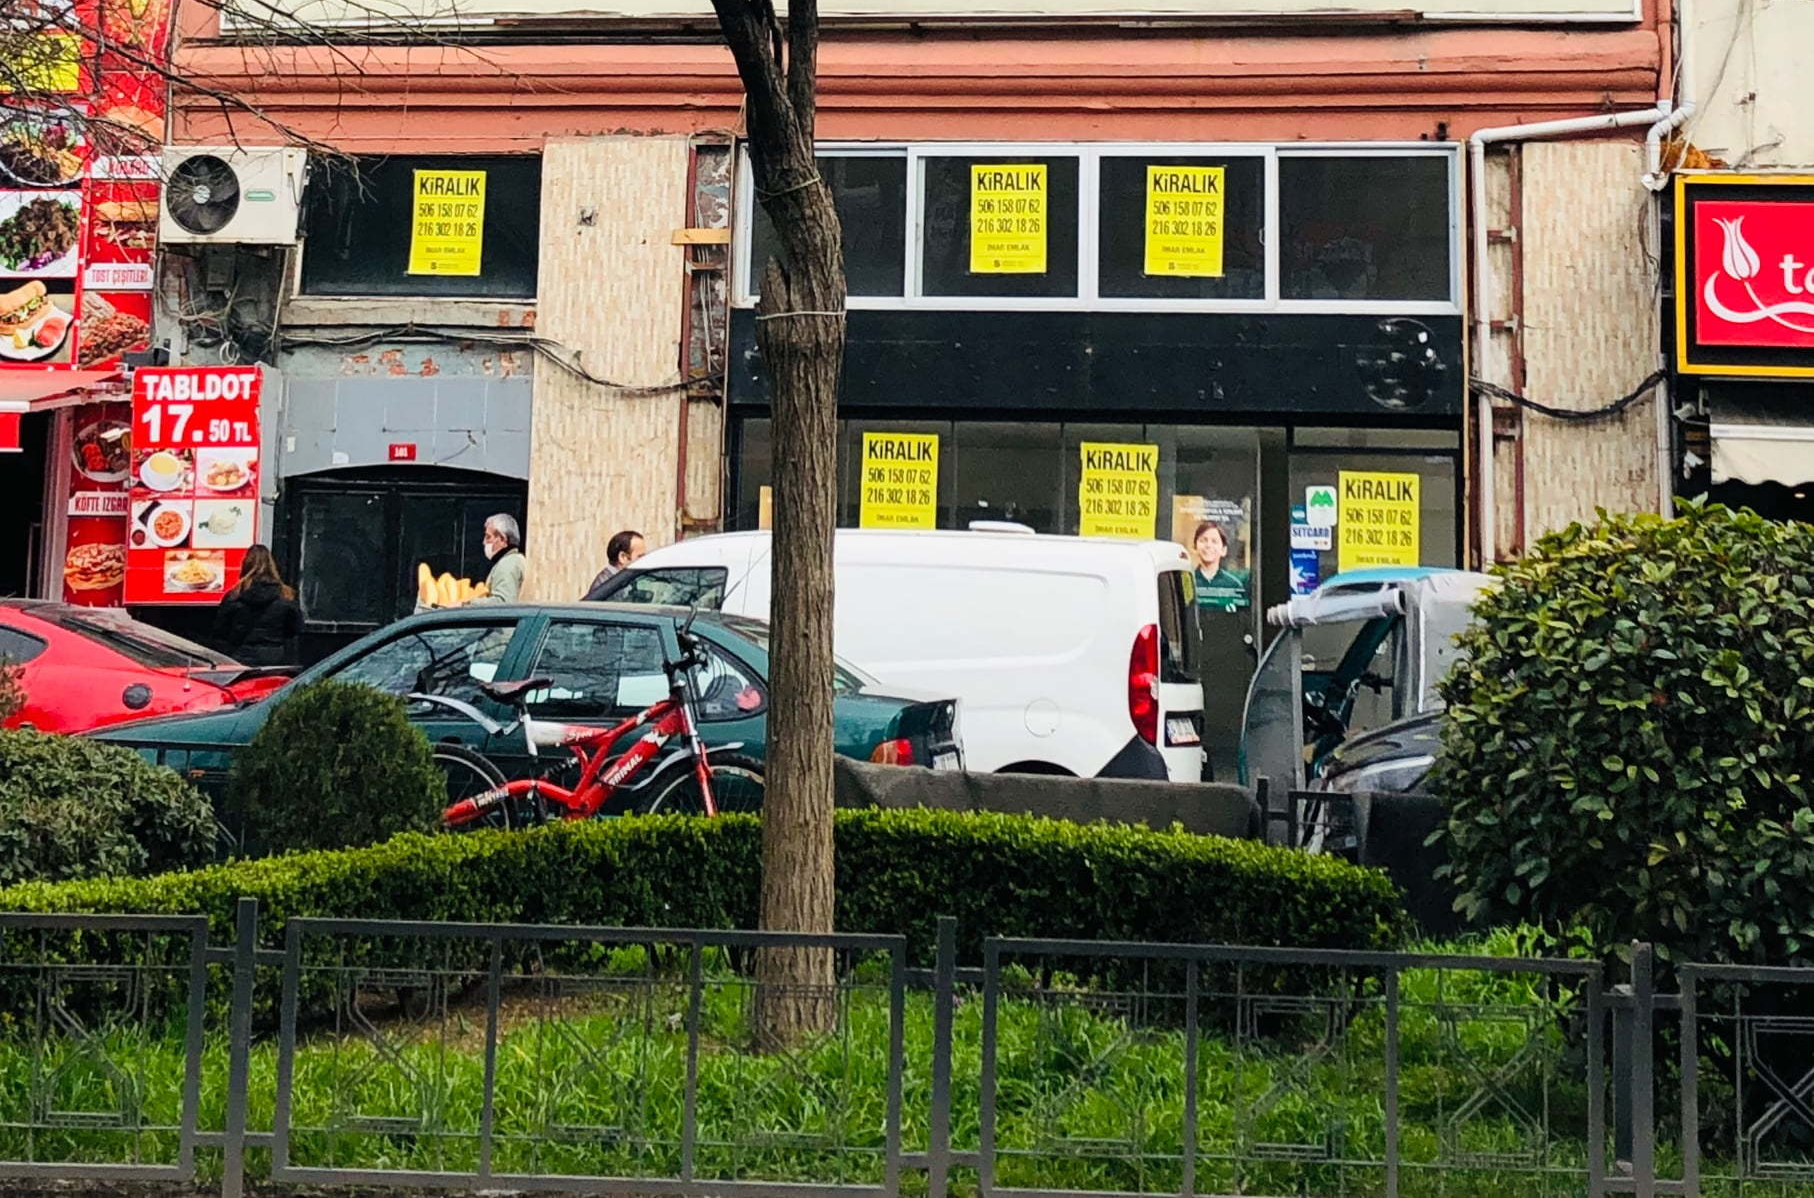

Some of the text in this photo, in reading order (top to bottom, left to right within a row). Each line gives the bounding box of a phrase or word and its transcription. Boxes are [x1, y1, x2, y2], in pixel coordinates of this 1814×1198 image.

[418, 203, 478, 218] 506 158 07 62
[977, 199, 1041, 214] 506 158 07 62
[1153, 201, 1217, 217] 506 158 07 62
[418, 222, 477, 237] 216 302 18 26
[977, 218, 1040, 233] 216 302 18 26
[1152, 219, 1217, 236] 216 302 18 26
[142, 373, 256, 401] TABLDOT
[233, 422, 252, 442] TL
[868, 467, 931, 485] 506 158 07 62
[1086, 478, 1151, 495] 506 158 07 62
[867, 487, 930, 505] 216 302 18 26
[1086, 499, 1150, 516] 216 302 18 26
[1346, 508, 1412, 526] 506 158 07 62
[1345, 528, 1412, 546] 216 302 18 26
